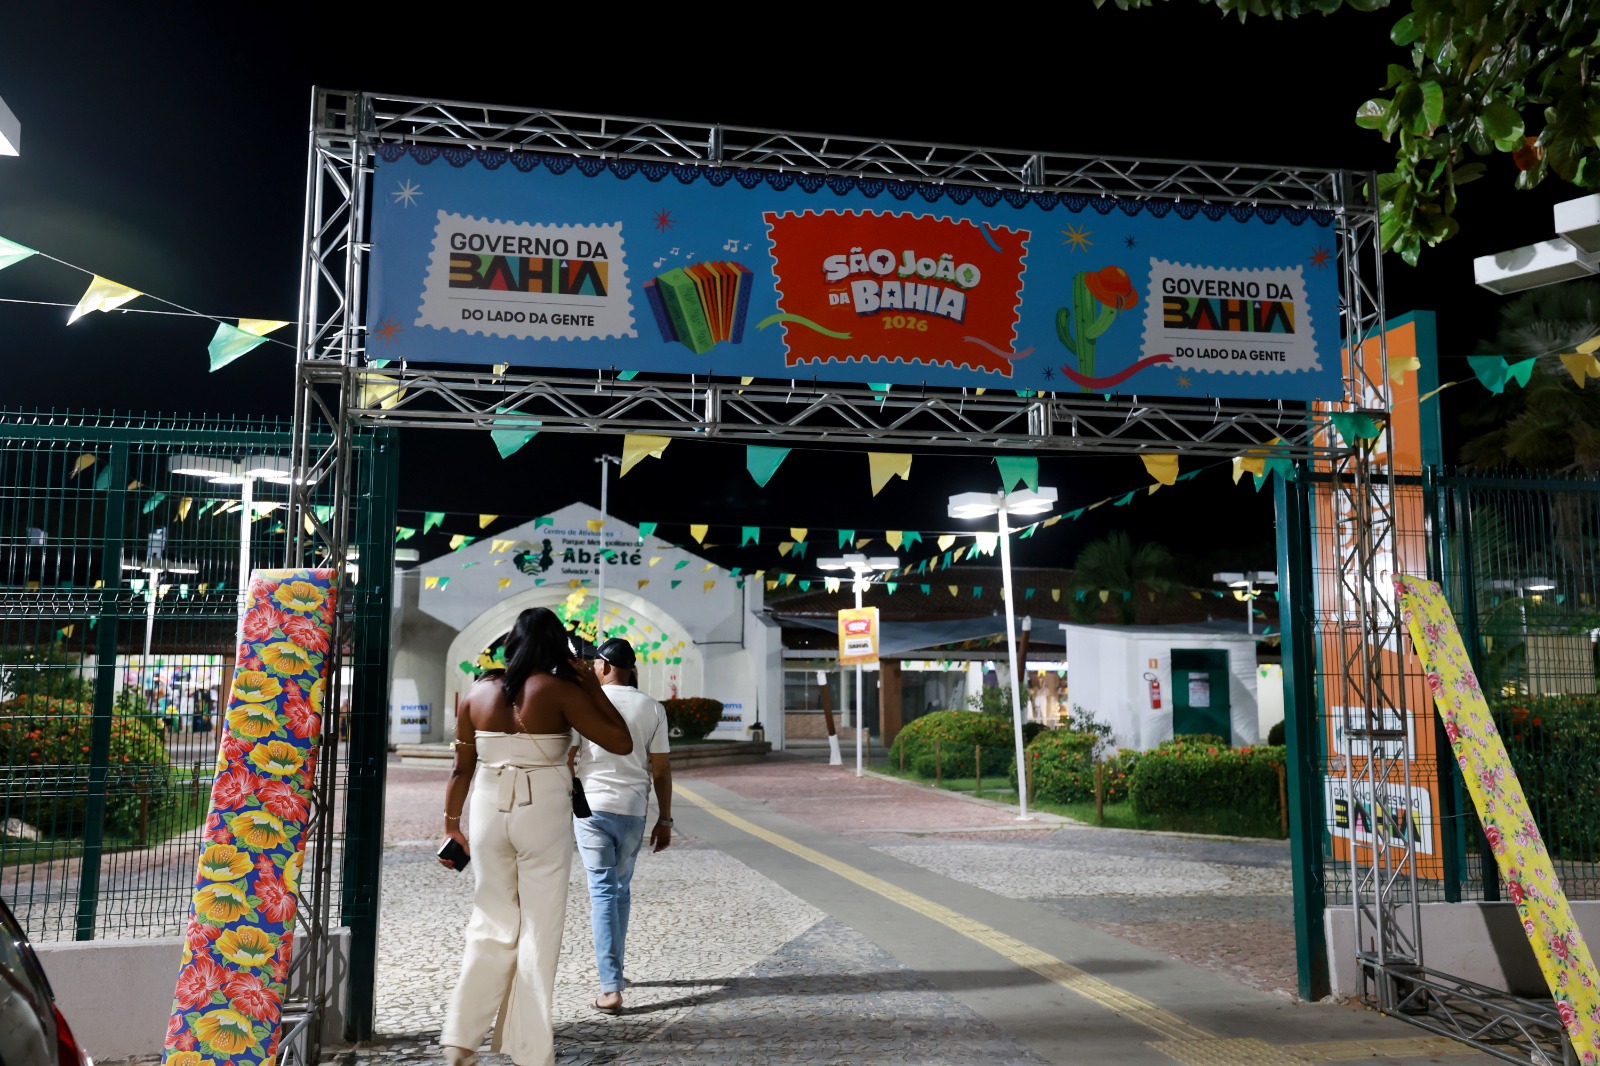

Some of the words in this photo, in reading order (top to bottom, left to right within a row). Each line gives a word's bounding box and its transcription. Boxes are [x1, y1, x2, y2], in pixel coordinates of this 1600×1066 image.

[450, 232, 569, 257] GOVERNO
[576, 240, 608, 259] DA
[449, 252, 608, 297] BAHIA
[822, 246, 897, 284] SÃO
[828, 291, 850, 305] DA
[851, 269, 967, 323] BAHIA
[1162, 277, 1260, 298] GOVERNO
[1266, 282, 1293, 300] DA
[461, 308, 484, 320] DO
[487, 309, 526, 323] LADO
[529, 312, 548, 325] DA
[551, 313, 595, 327] GENTE
[882, 315, 928, 332] 2026
[1163, 296, 1295, 334] BAHIA
[1176, 346, 1194, 358] DO
[1197, 348, 1229, 360] LADO
[1231, 350, 1247, 360] DA
[1249, 350, 1286, 362] GENTE
[543, 527, 566, 536] Centro
[578, 529, 614, 538] Atividaes
[562, 538, 585, 546] Parque
[587, 539, 633, 548] Metpolitano
[562, 548, 642, 566] Abaeté
[561, 567, 589, 576] Salvador
